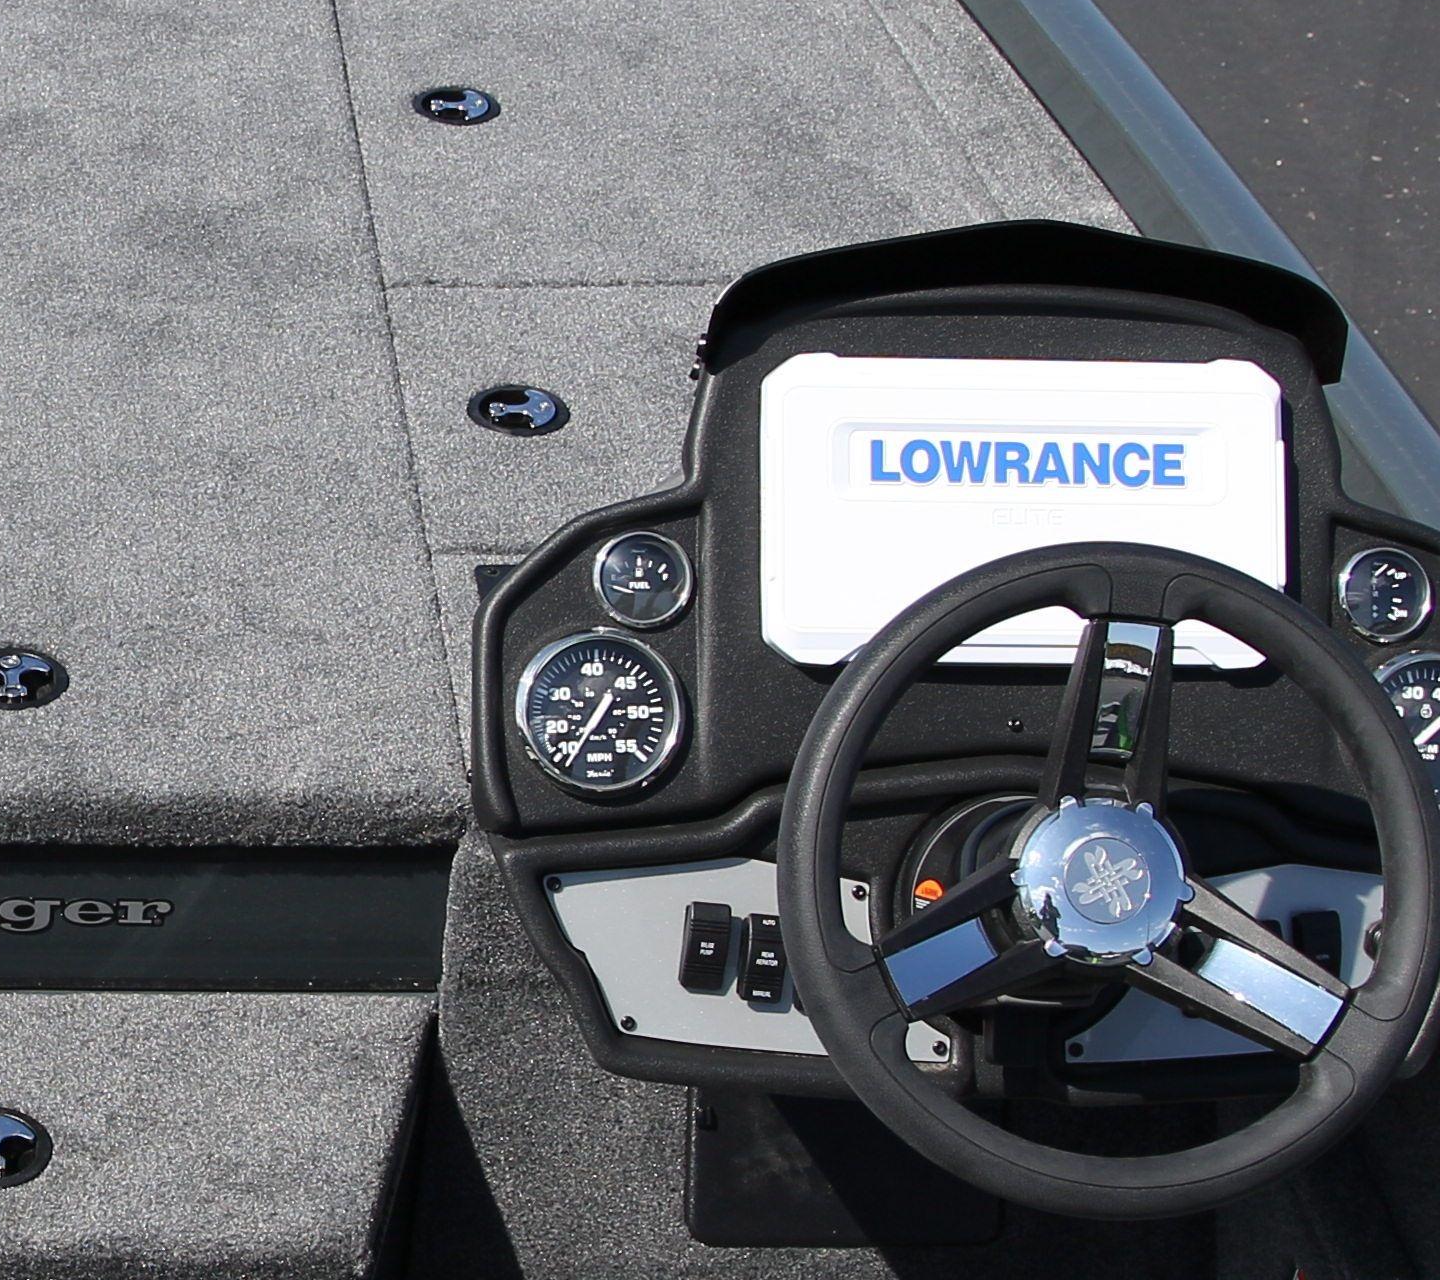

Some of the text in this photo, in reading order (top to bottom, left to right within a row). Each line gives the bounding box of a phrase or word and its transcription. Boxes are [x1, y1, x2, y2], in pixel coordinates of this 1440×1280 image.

[870, 438, 1187, 488] LOWRANCE
[991, 507, 1065, 527] ELITE
[629, 581, 651, 589] FUEL
[580, 662, 604, 676] 40
[614, 676, 637, 690] 45
[548, 687, 571, 701] 30
[1402, 686, 1424, 700] 30
[627, 705, 650, 719] 50
[546, 720, 568, 734] 20
[558, 741, 579, 755] 10
[615, 739, 637, 753] 55
[586, 752, 613, 763] MPH
